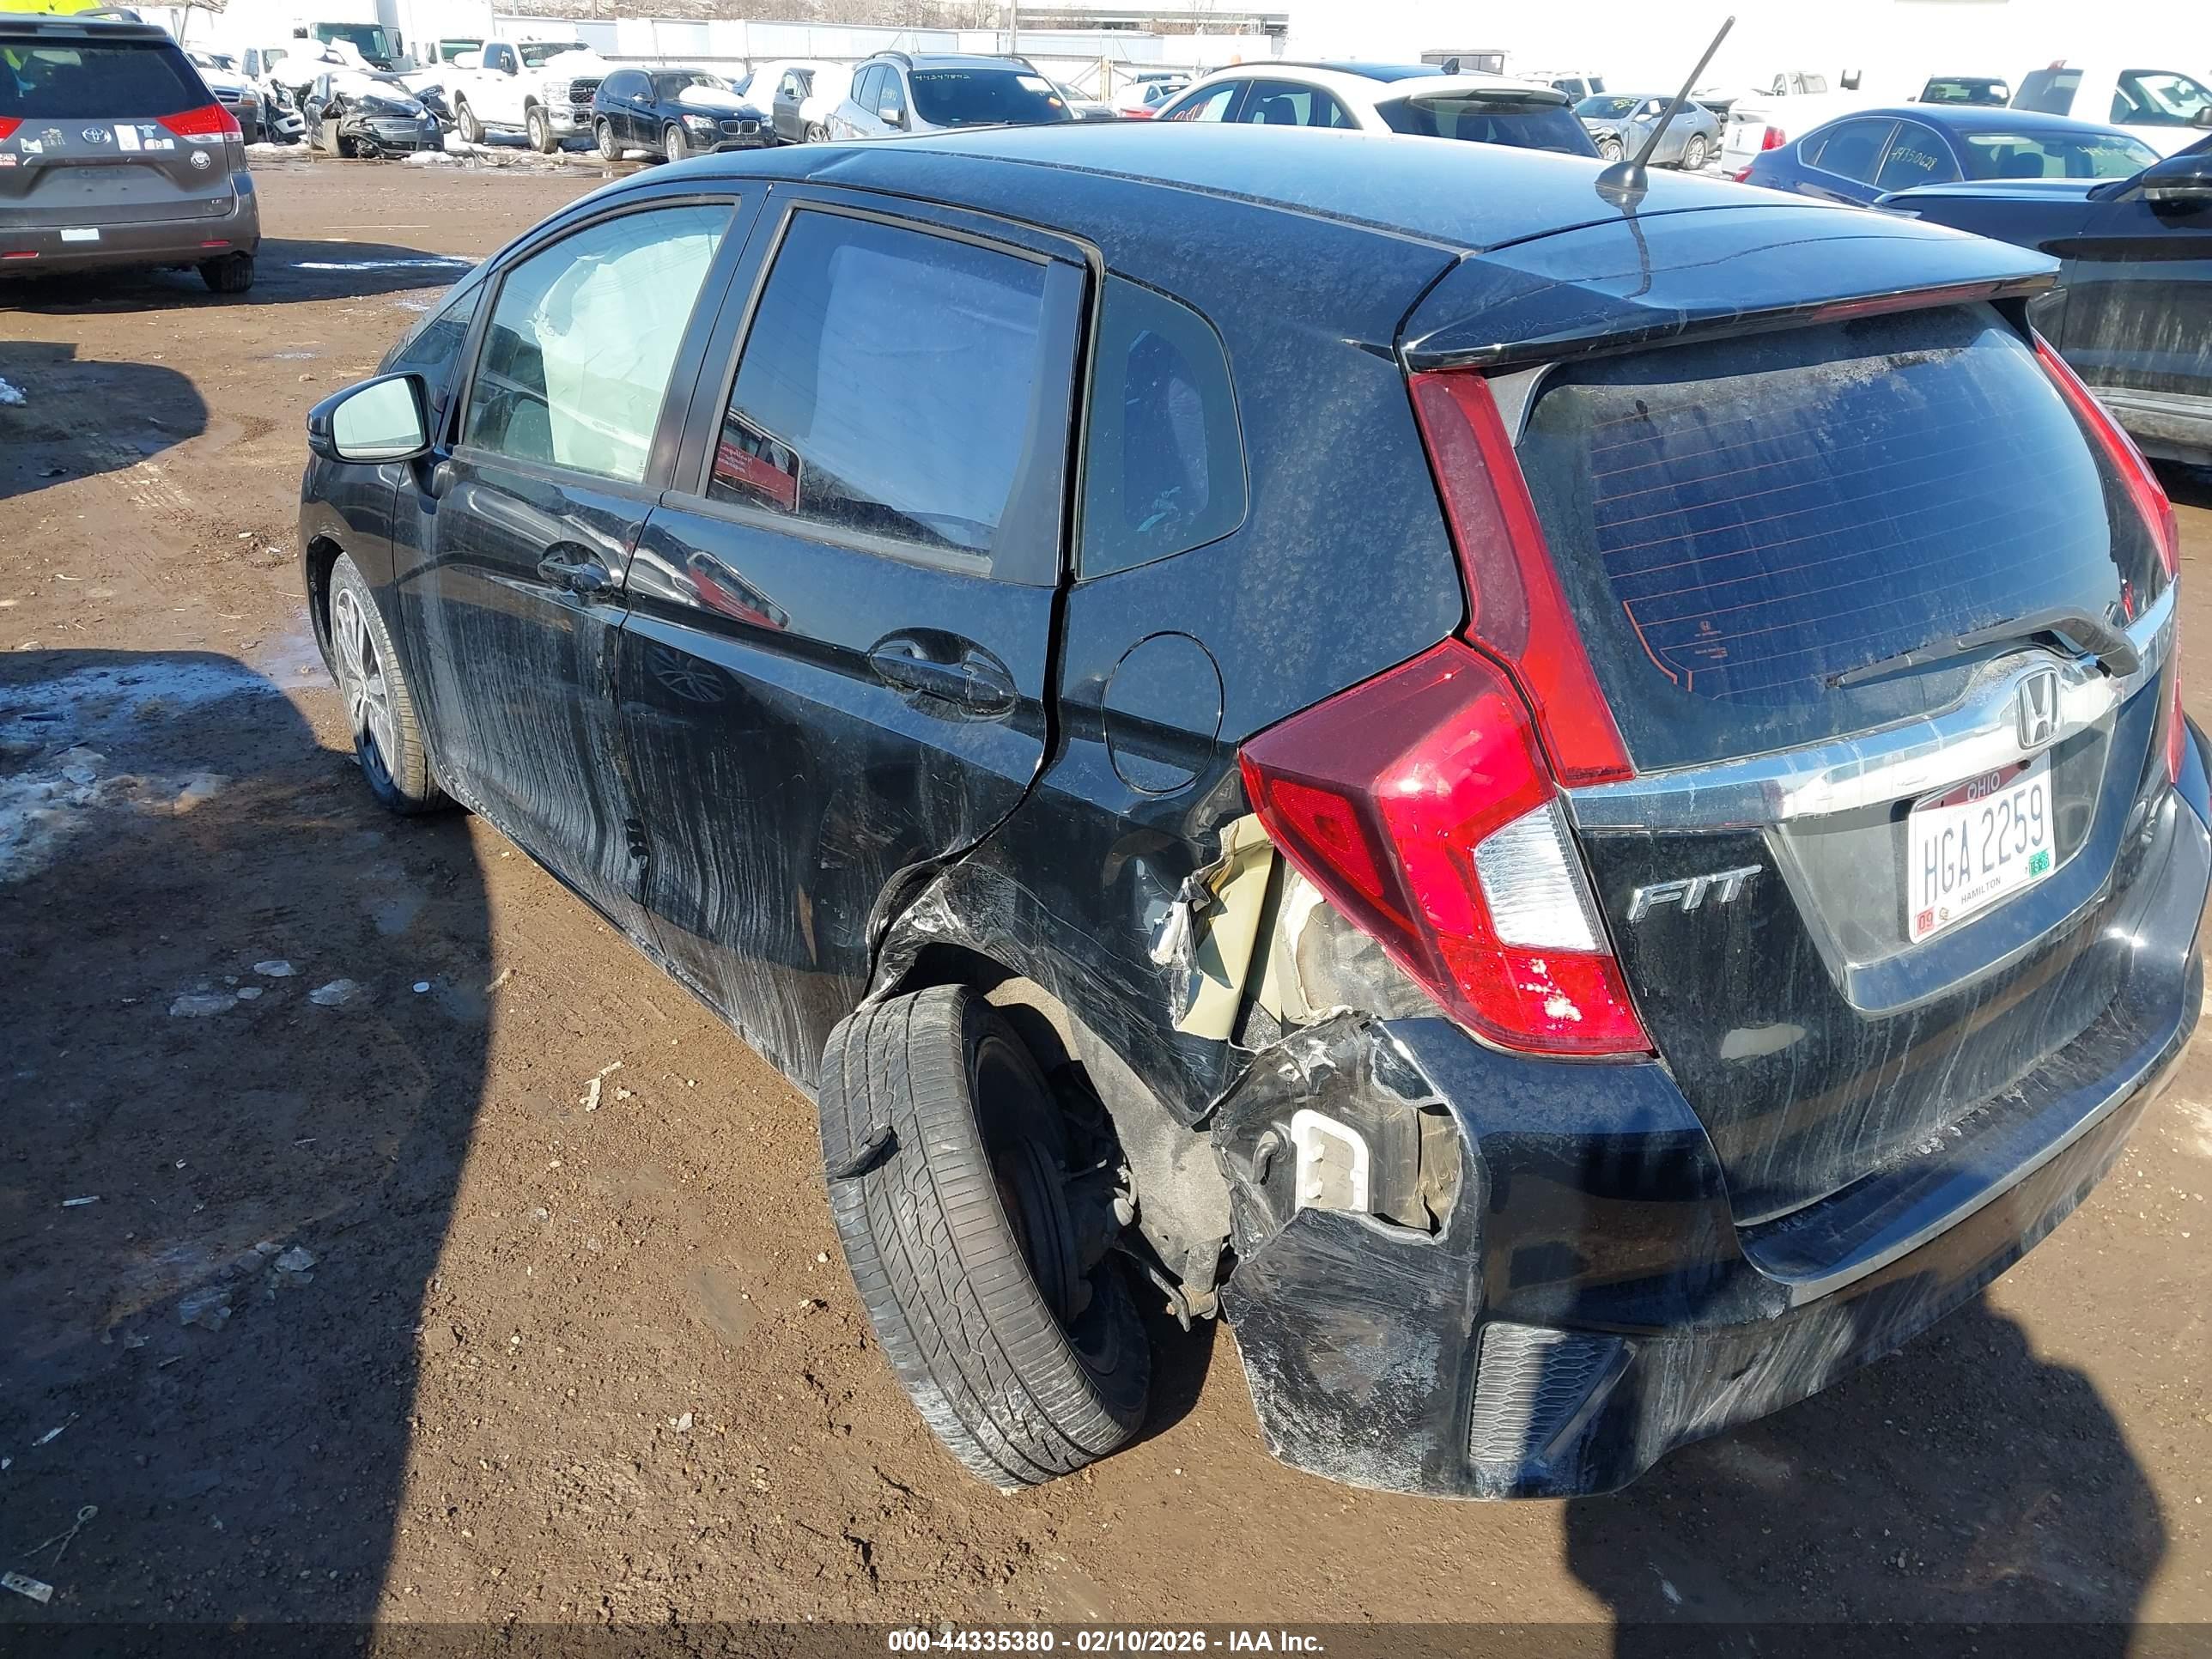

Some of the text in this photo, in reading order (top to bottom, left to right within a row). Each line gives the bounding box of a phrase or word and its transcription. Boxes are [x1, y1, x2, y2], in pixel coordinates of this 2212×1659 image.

[1967, 772, 2001, 801] OHIO
[1924, 784, 2044, 906] HGA 2259
[1627, 864, 1763, 921] FIT
[1961, 877, 2002, 904] HAMILTON
[1919, 912, 1933, 930] 09
